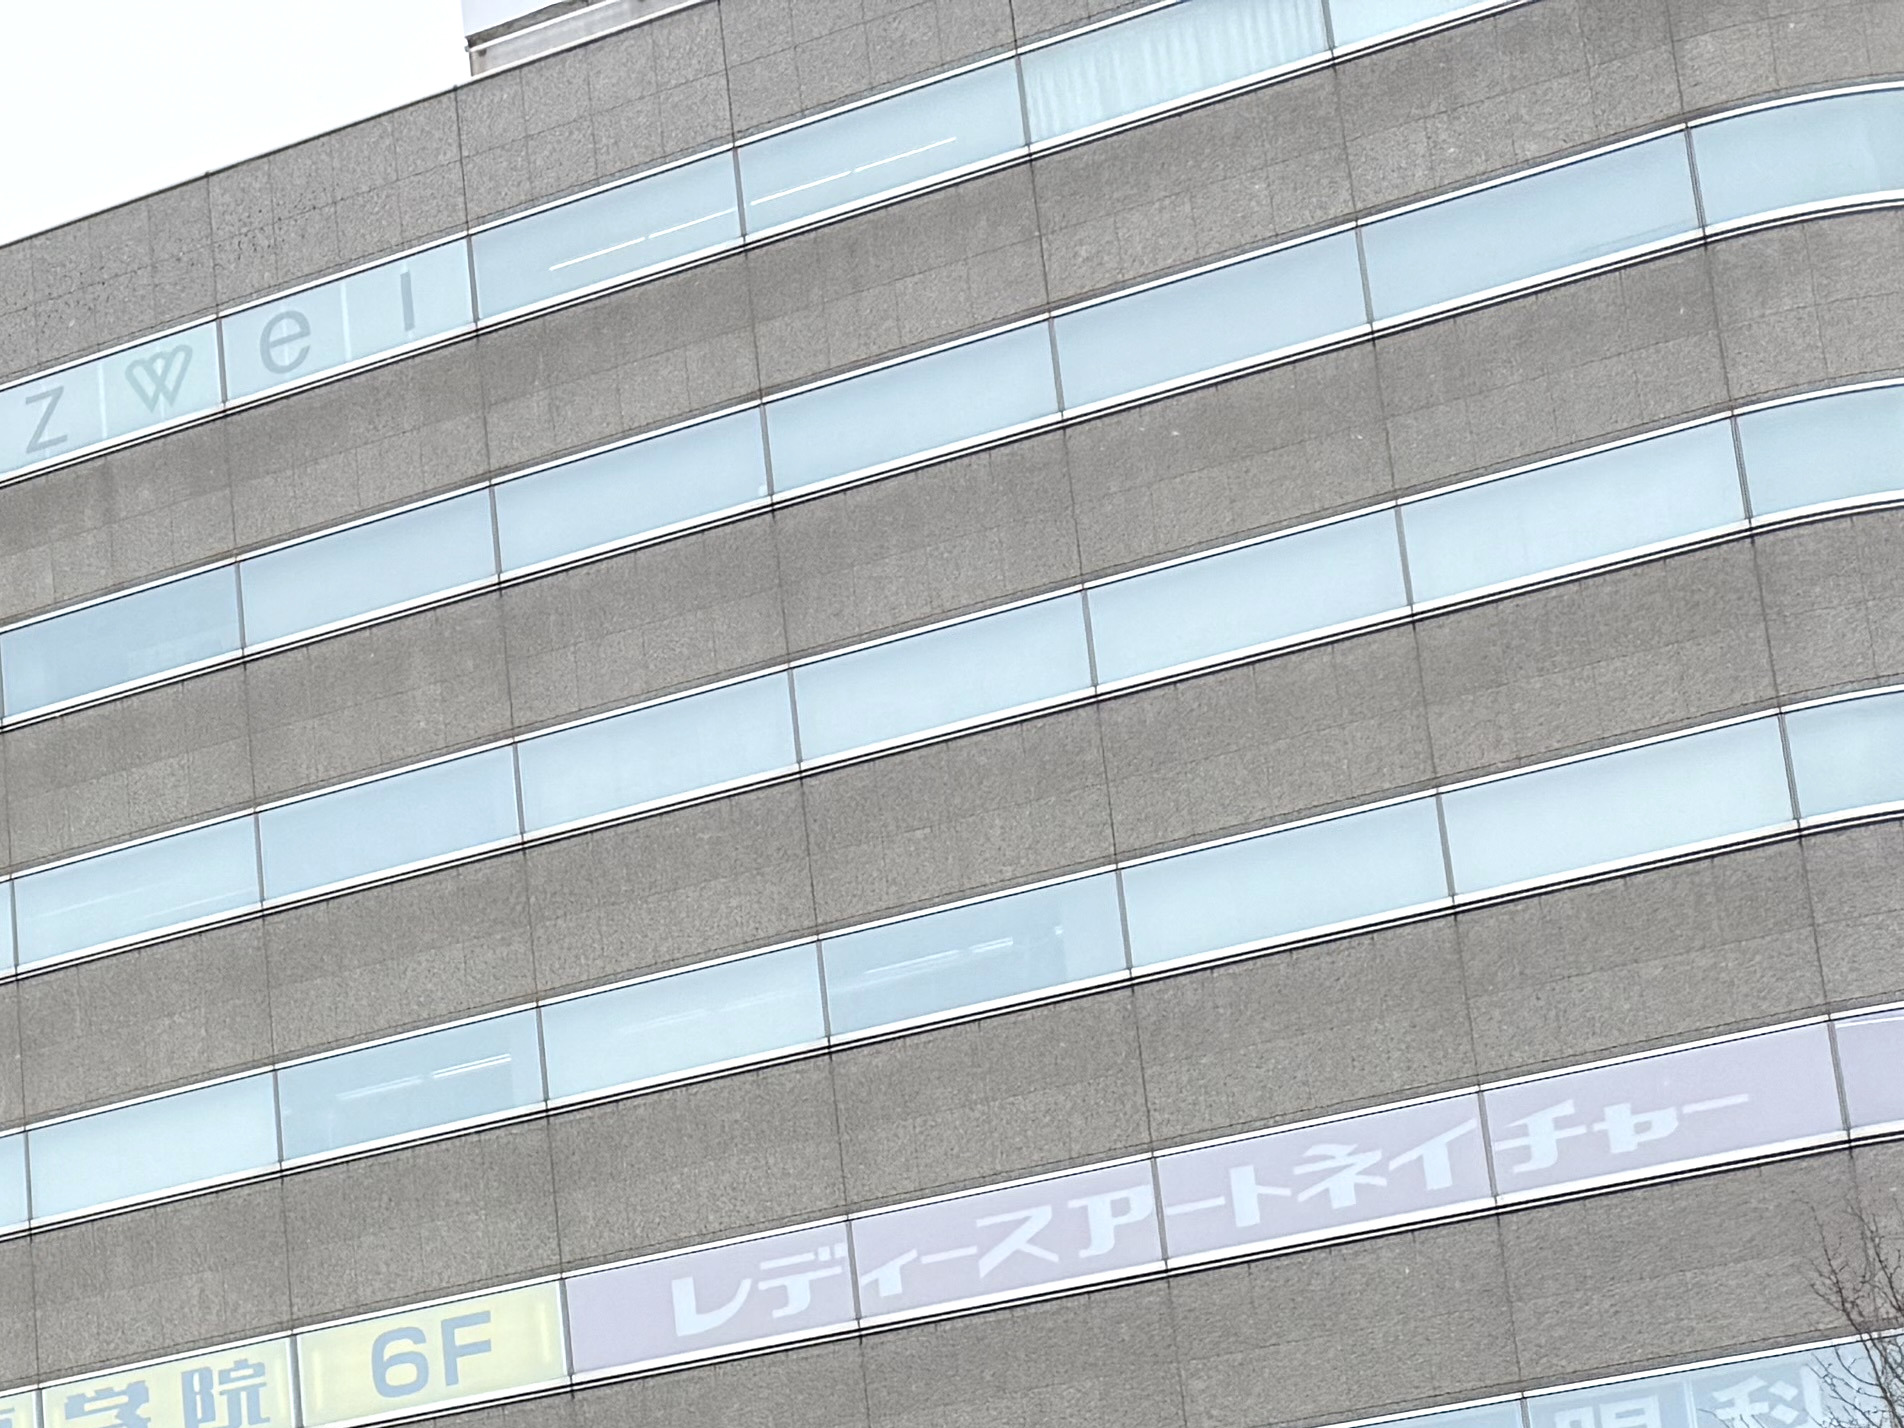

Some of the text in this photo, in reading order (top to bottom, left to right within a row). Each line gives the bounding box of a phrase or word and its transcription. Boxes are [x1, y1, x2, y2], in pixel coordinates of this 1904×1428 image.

[671, 1090, 1752, 1337] レディースアートネイチャー
[369, 1308, 494, 1399] 6F
